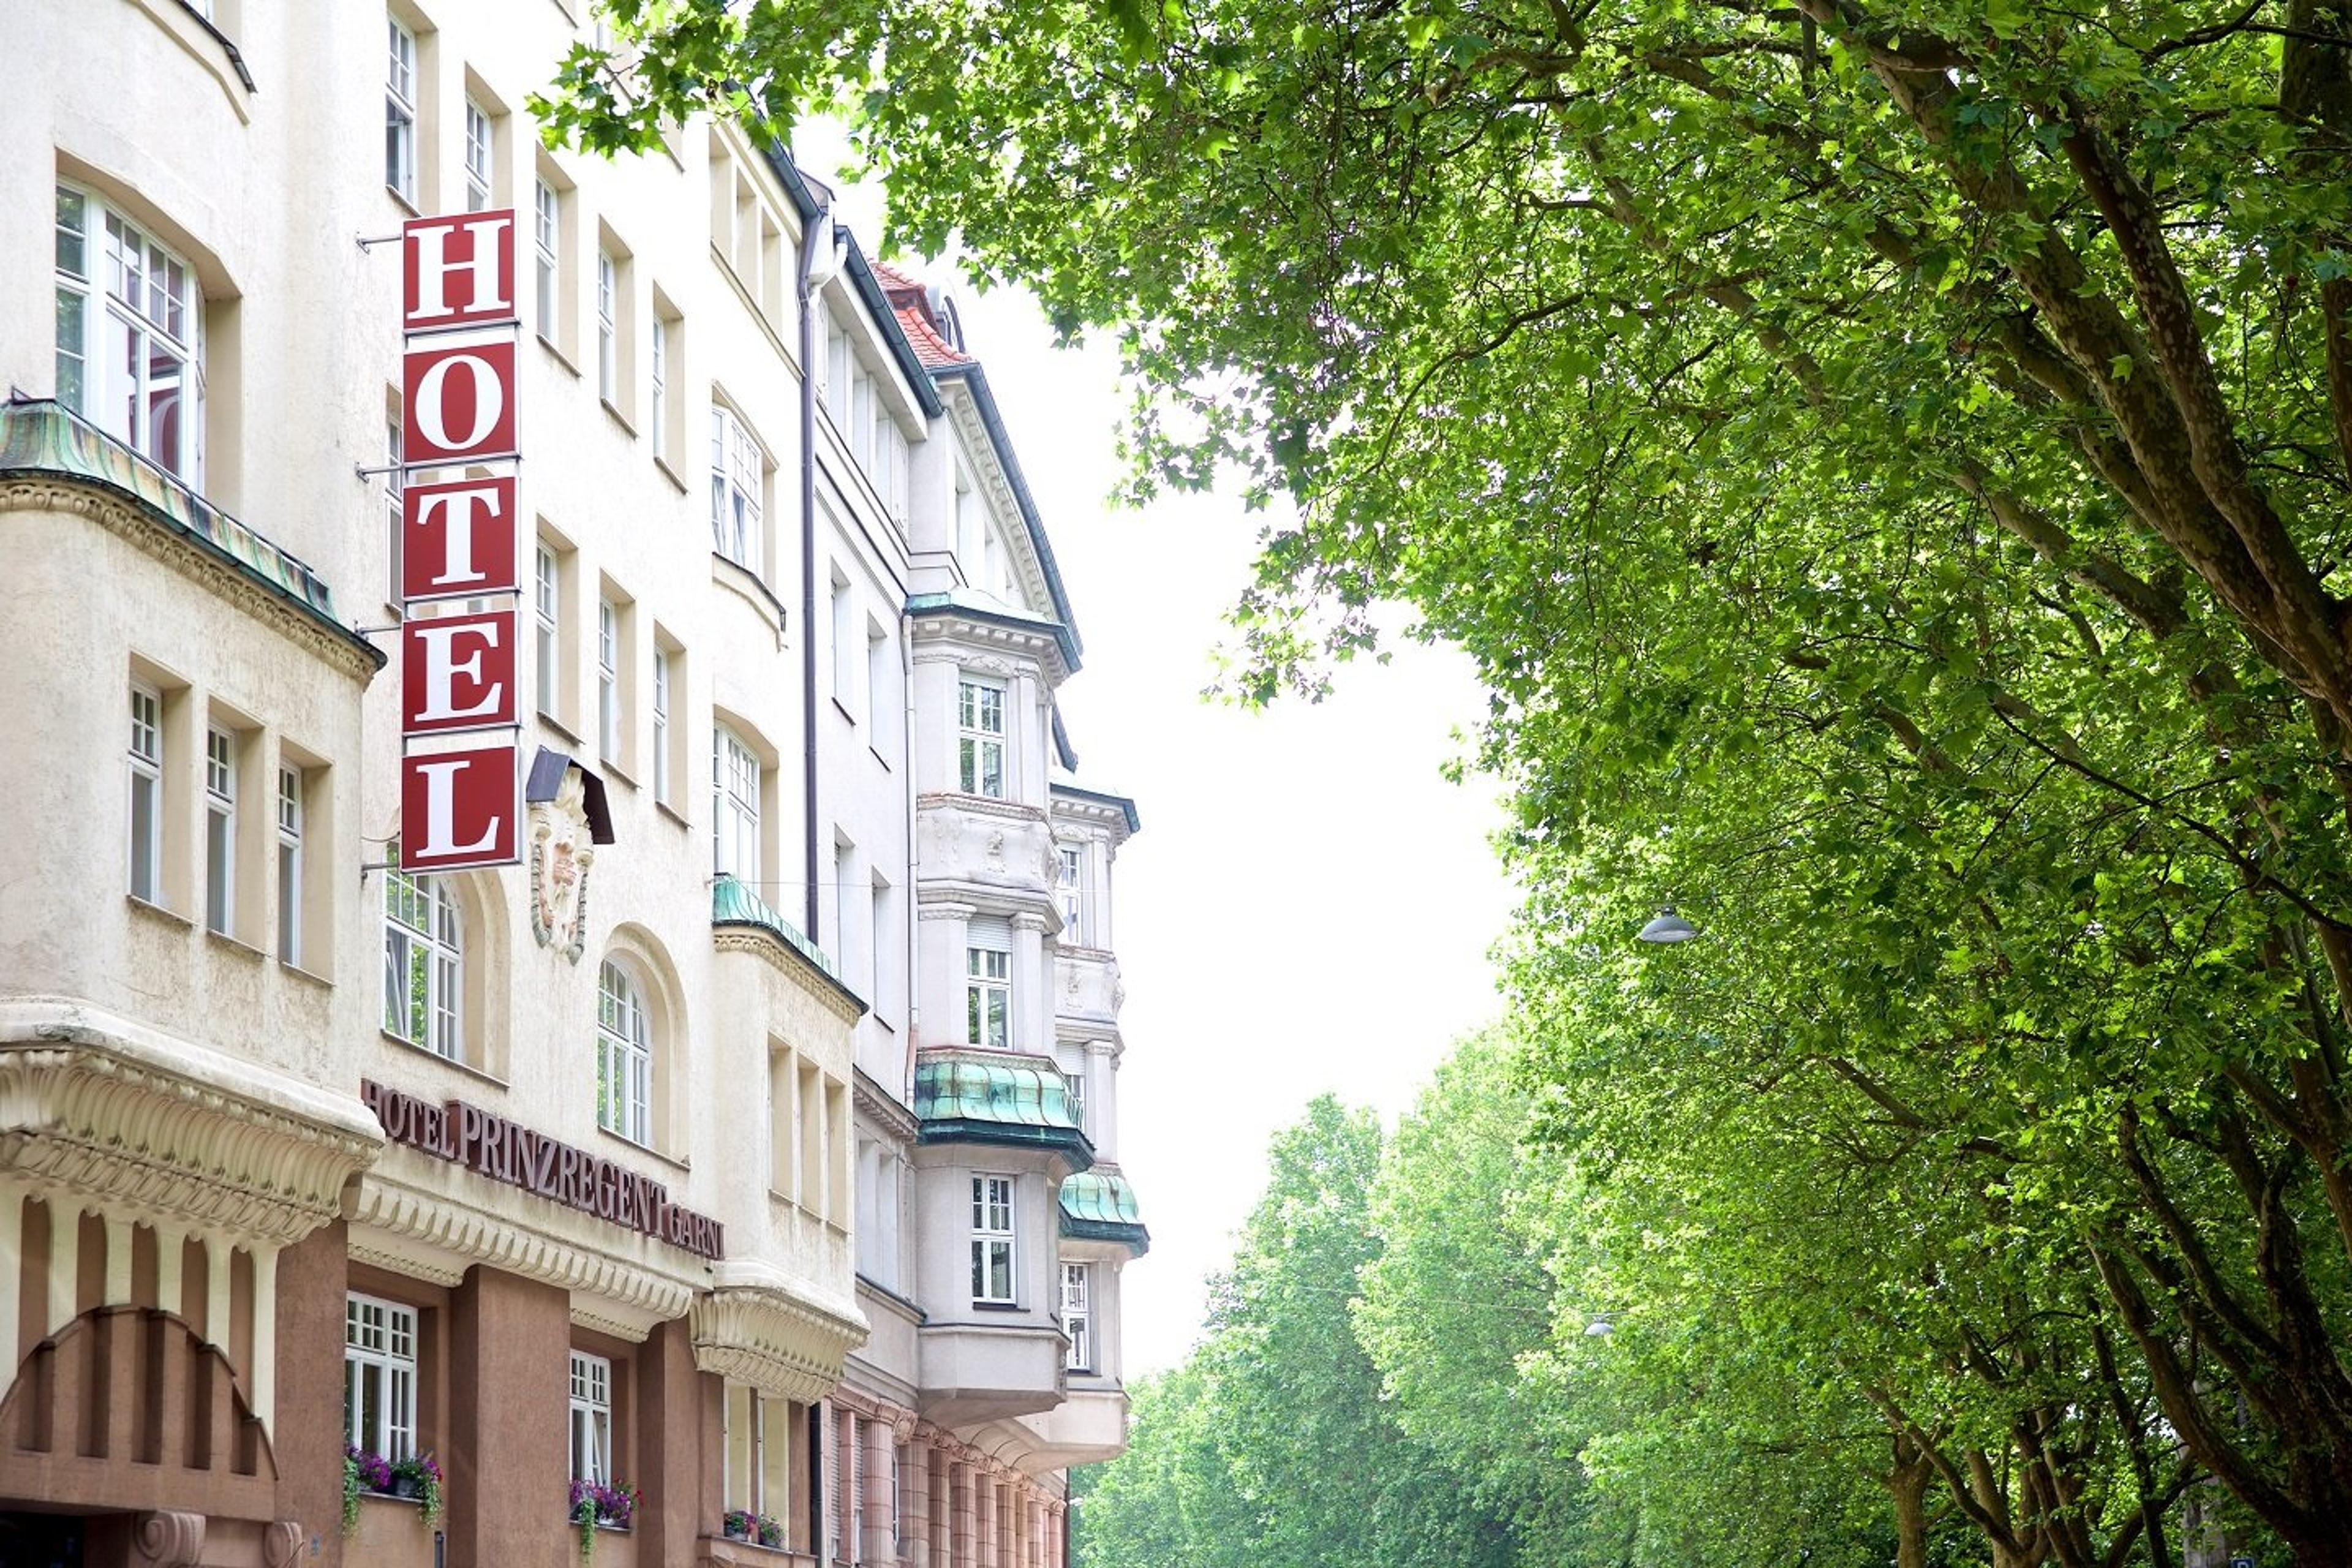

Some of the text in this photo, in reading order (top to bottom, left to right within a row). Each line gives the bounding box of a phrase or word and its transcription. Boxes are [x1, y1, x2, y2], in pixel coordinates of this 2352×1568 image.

[407, 219, 511, 858] HOTEL
[361, 1078, 725, 1261] HOTEL PRINZREGENT GARNI
